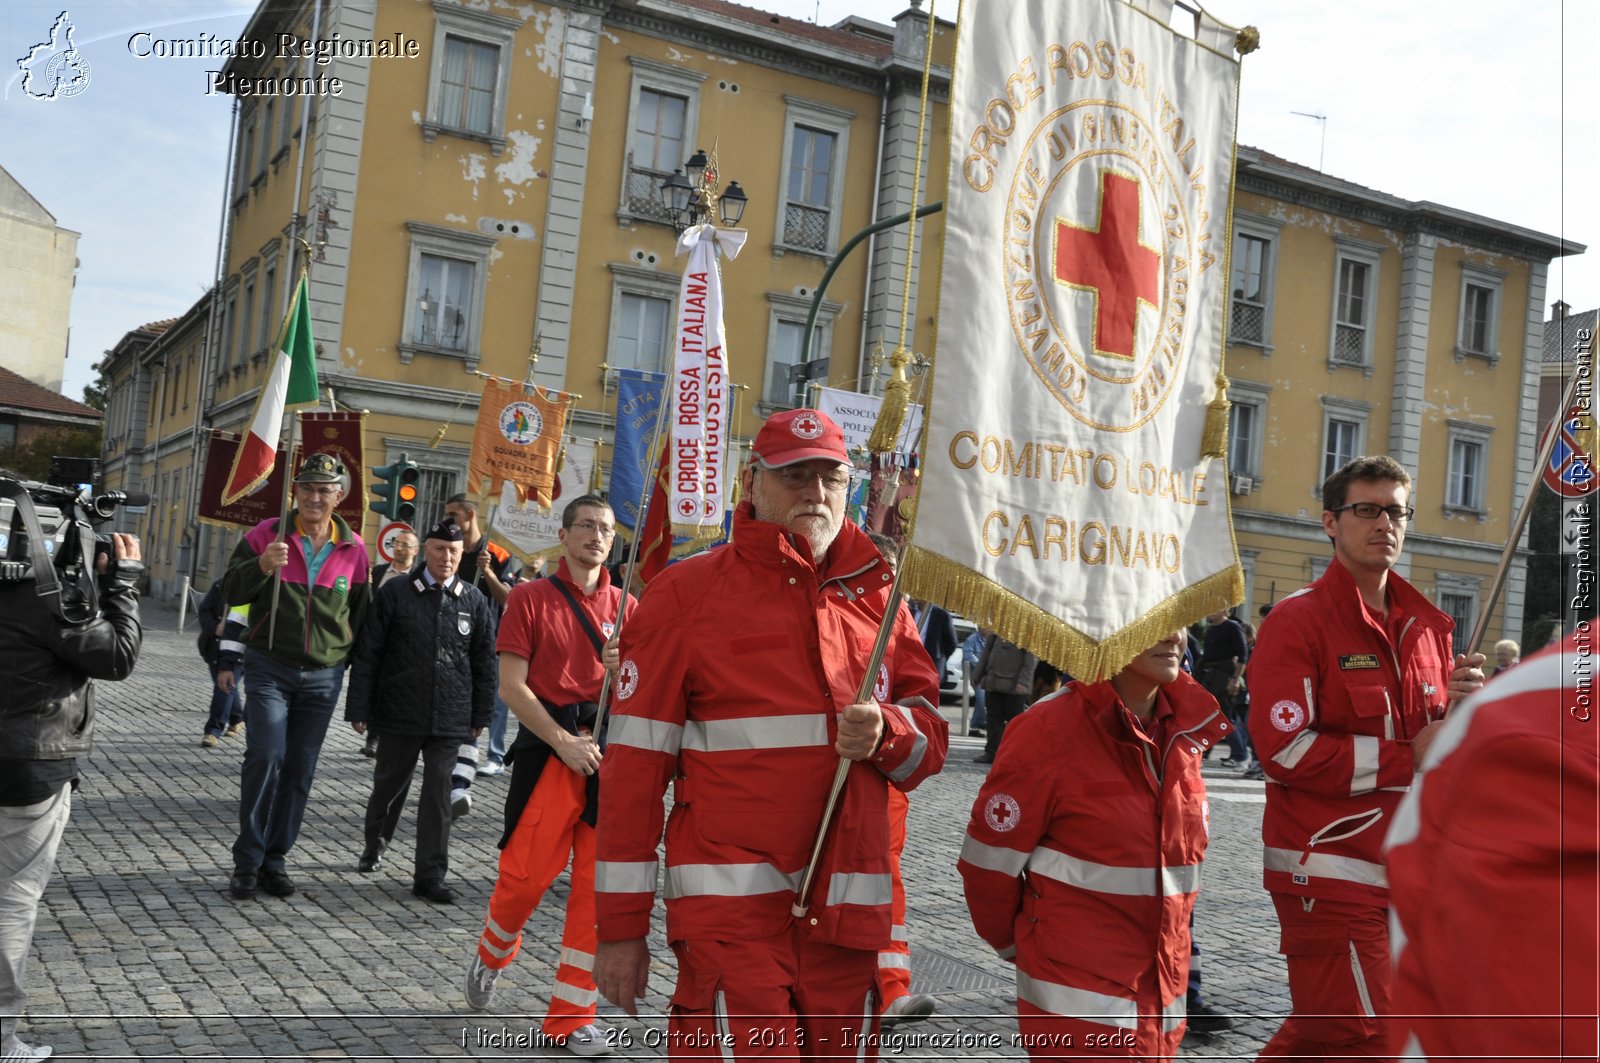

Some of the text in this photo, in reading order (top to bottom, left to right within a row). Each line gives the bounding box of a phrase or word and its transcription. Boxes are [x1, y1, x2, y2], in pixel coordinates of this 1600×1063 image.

[963, 40, 1216, 275] CROCE ROSSA ITALIANA
[1047, 121, 1077, 161] DI
[1165, 202, 1185, 246] 22
[1008, 156, 1088, 405] CONVENZIONE
[677, 271, 709, 495] CROCE ROSSA ITALIANA
[631, 408, 661, 430] GRUPP
[843, 435, 856, 445] EL
[493, 446, 527, 458] SQUADRA
[948, 430, 1209, 506] COMITATO LOCALE
[497, 516, 557, 536] NICHELIN
[981, 510, 1181, 574] CARIGNANO
